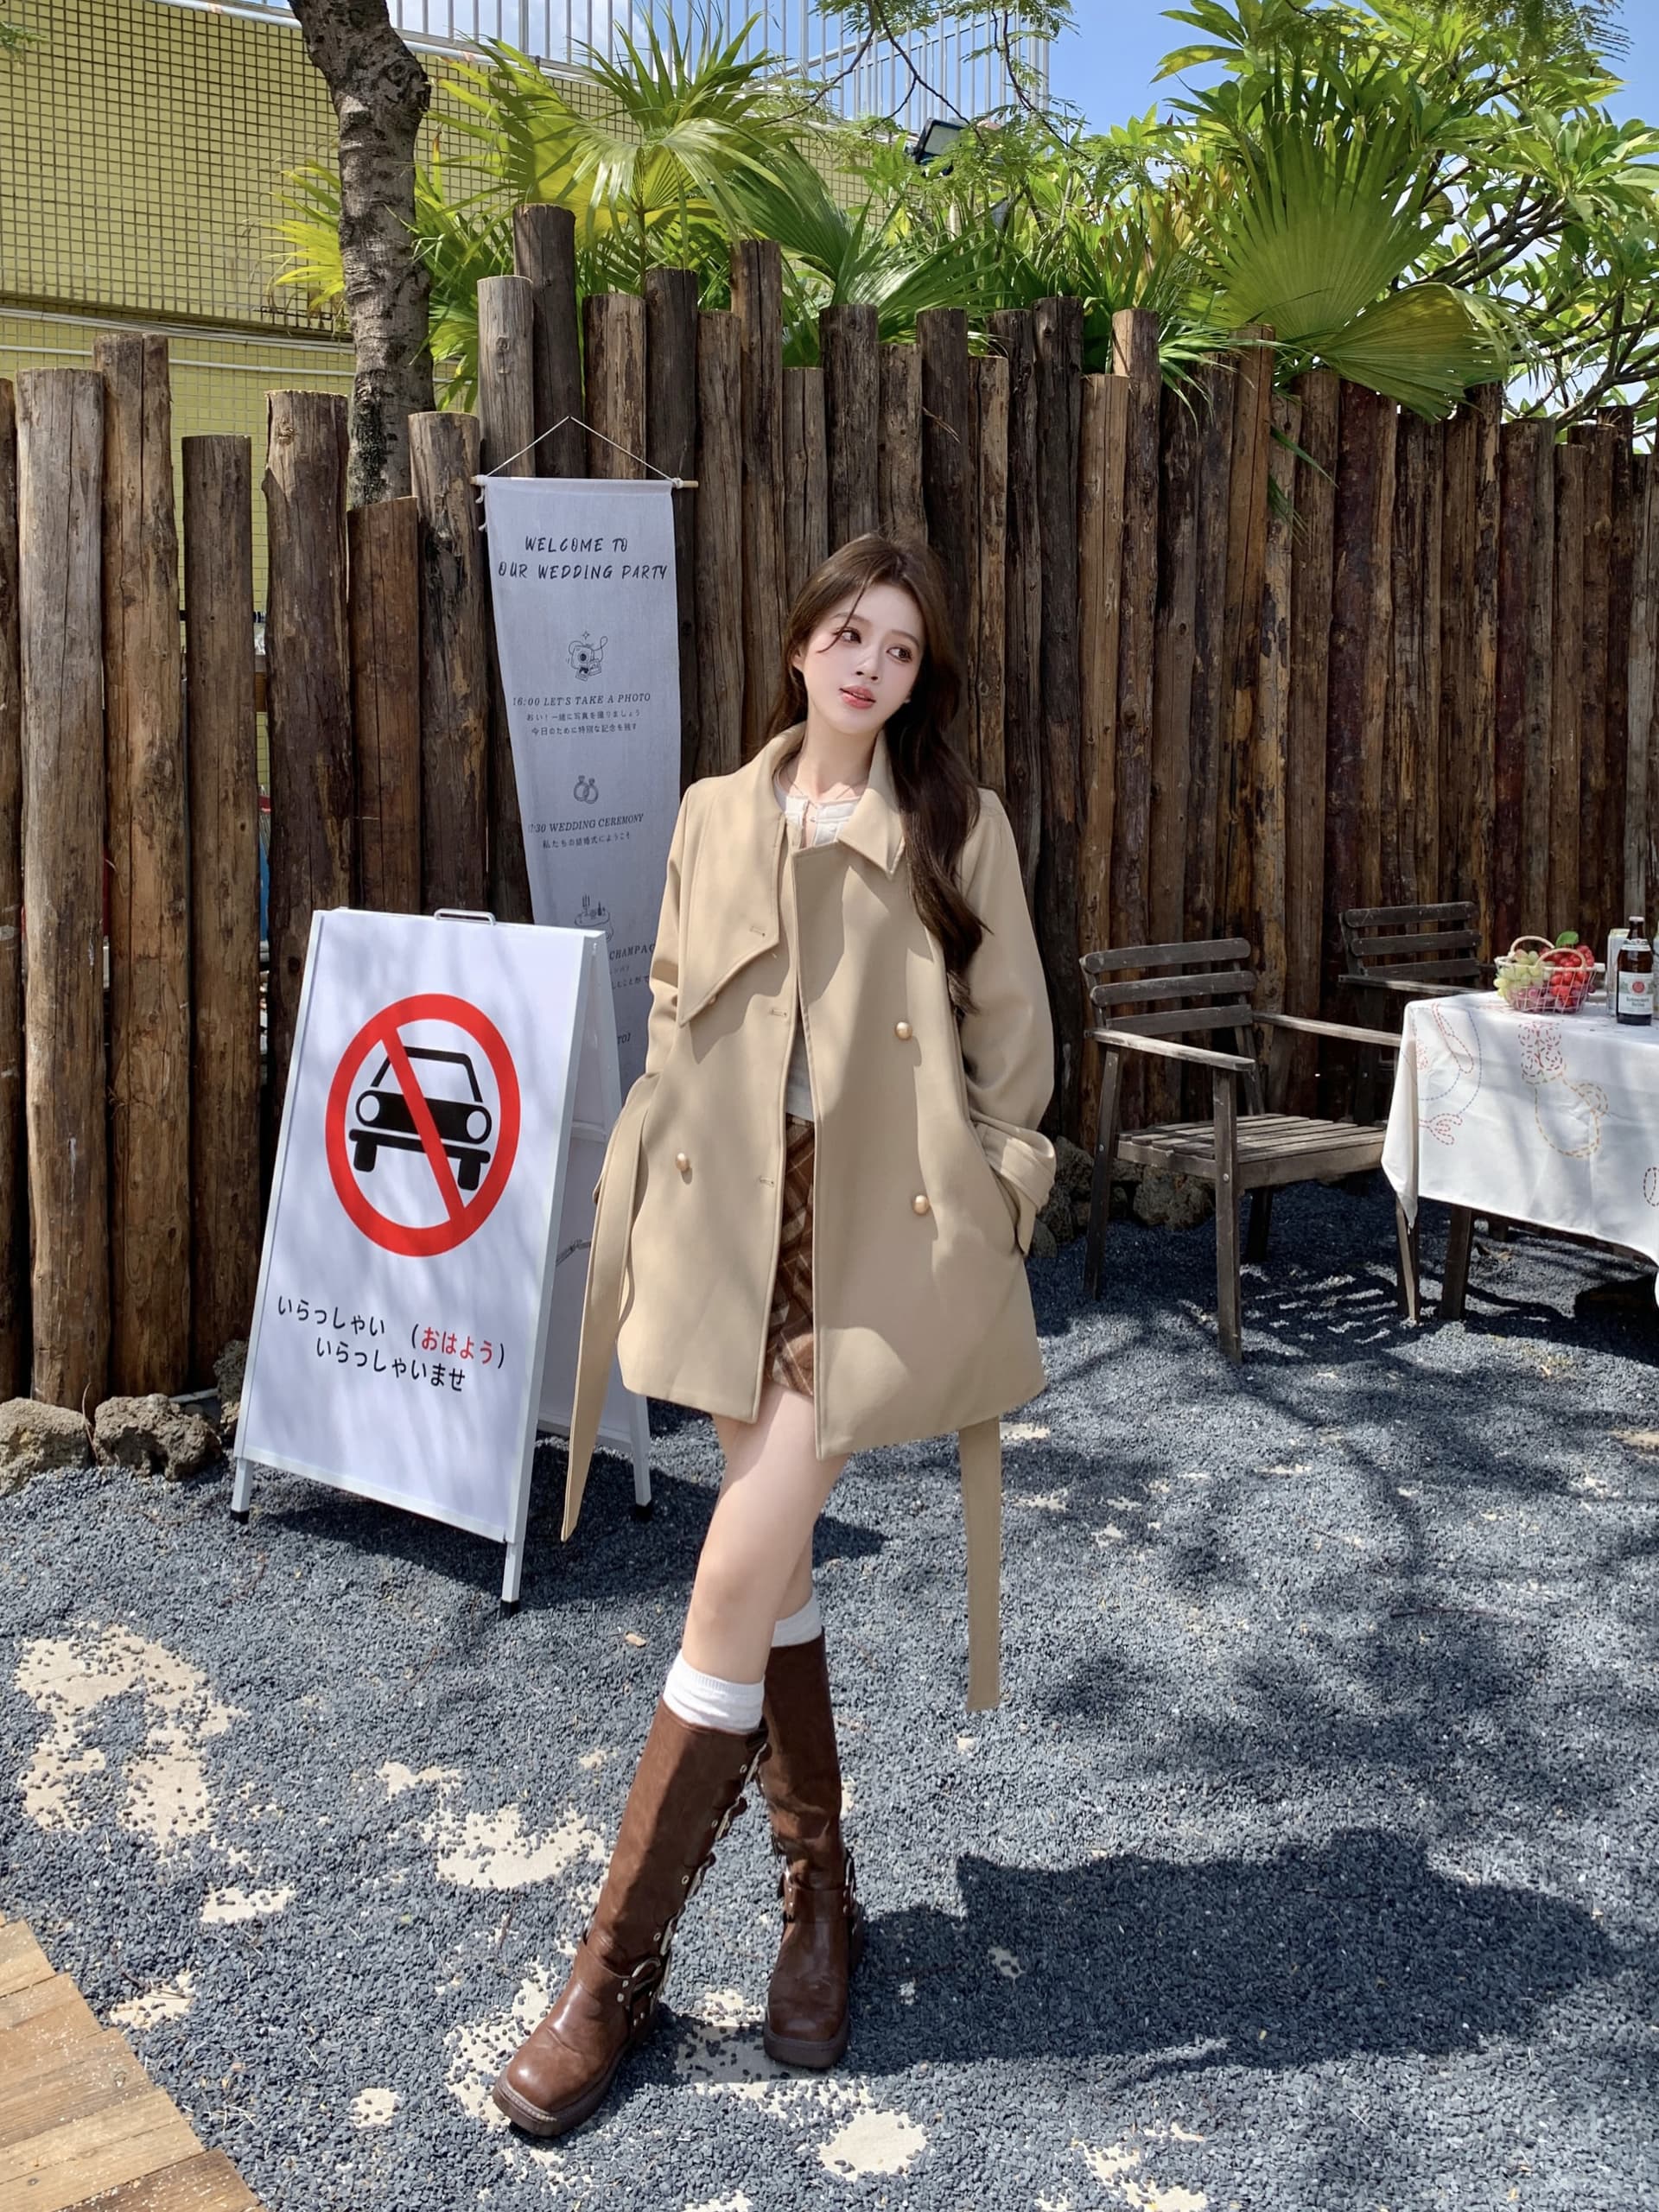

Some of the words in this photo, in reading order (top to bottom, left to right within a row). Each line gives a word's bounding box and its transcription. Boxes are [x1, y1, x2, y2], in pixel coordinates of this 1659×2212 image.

[524, 536, 604, 553] WELCOME
[613, 537, 628, 552] TO
[498, 561, 528, 578] OUR
[537, 564, 613, 580] WEDDING
[621, 564, 668, 580] PARTY
[512, 696, 540, 706] 16:00
[575, 695, 604, 705] TAKE
[607, 695, 614, 704] A
[617, 692, 651, 703] PHOTO
[549, 818, 596, 833] WEDDING
[598, 813, 644, 828] CEREMONY
[277, 1295, 385, 1337] いらっしゃい
[316, 1337, 466, 1392] いらっしゃいませ
